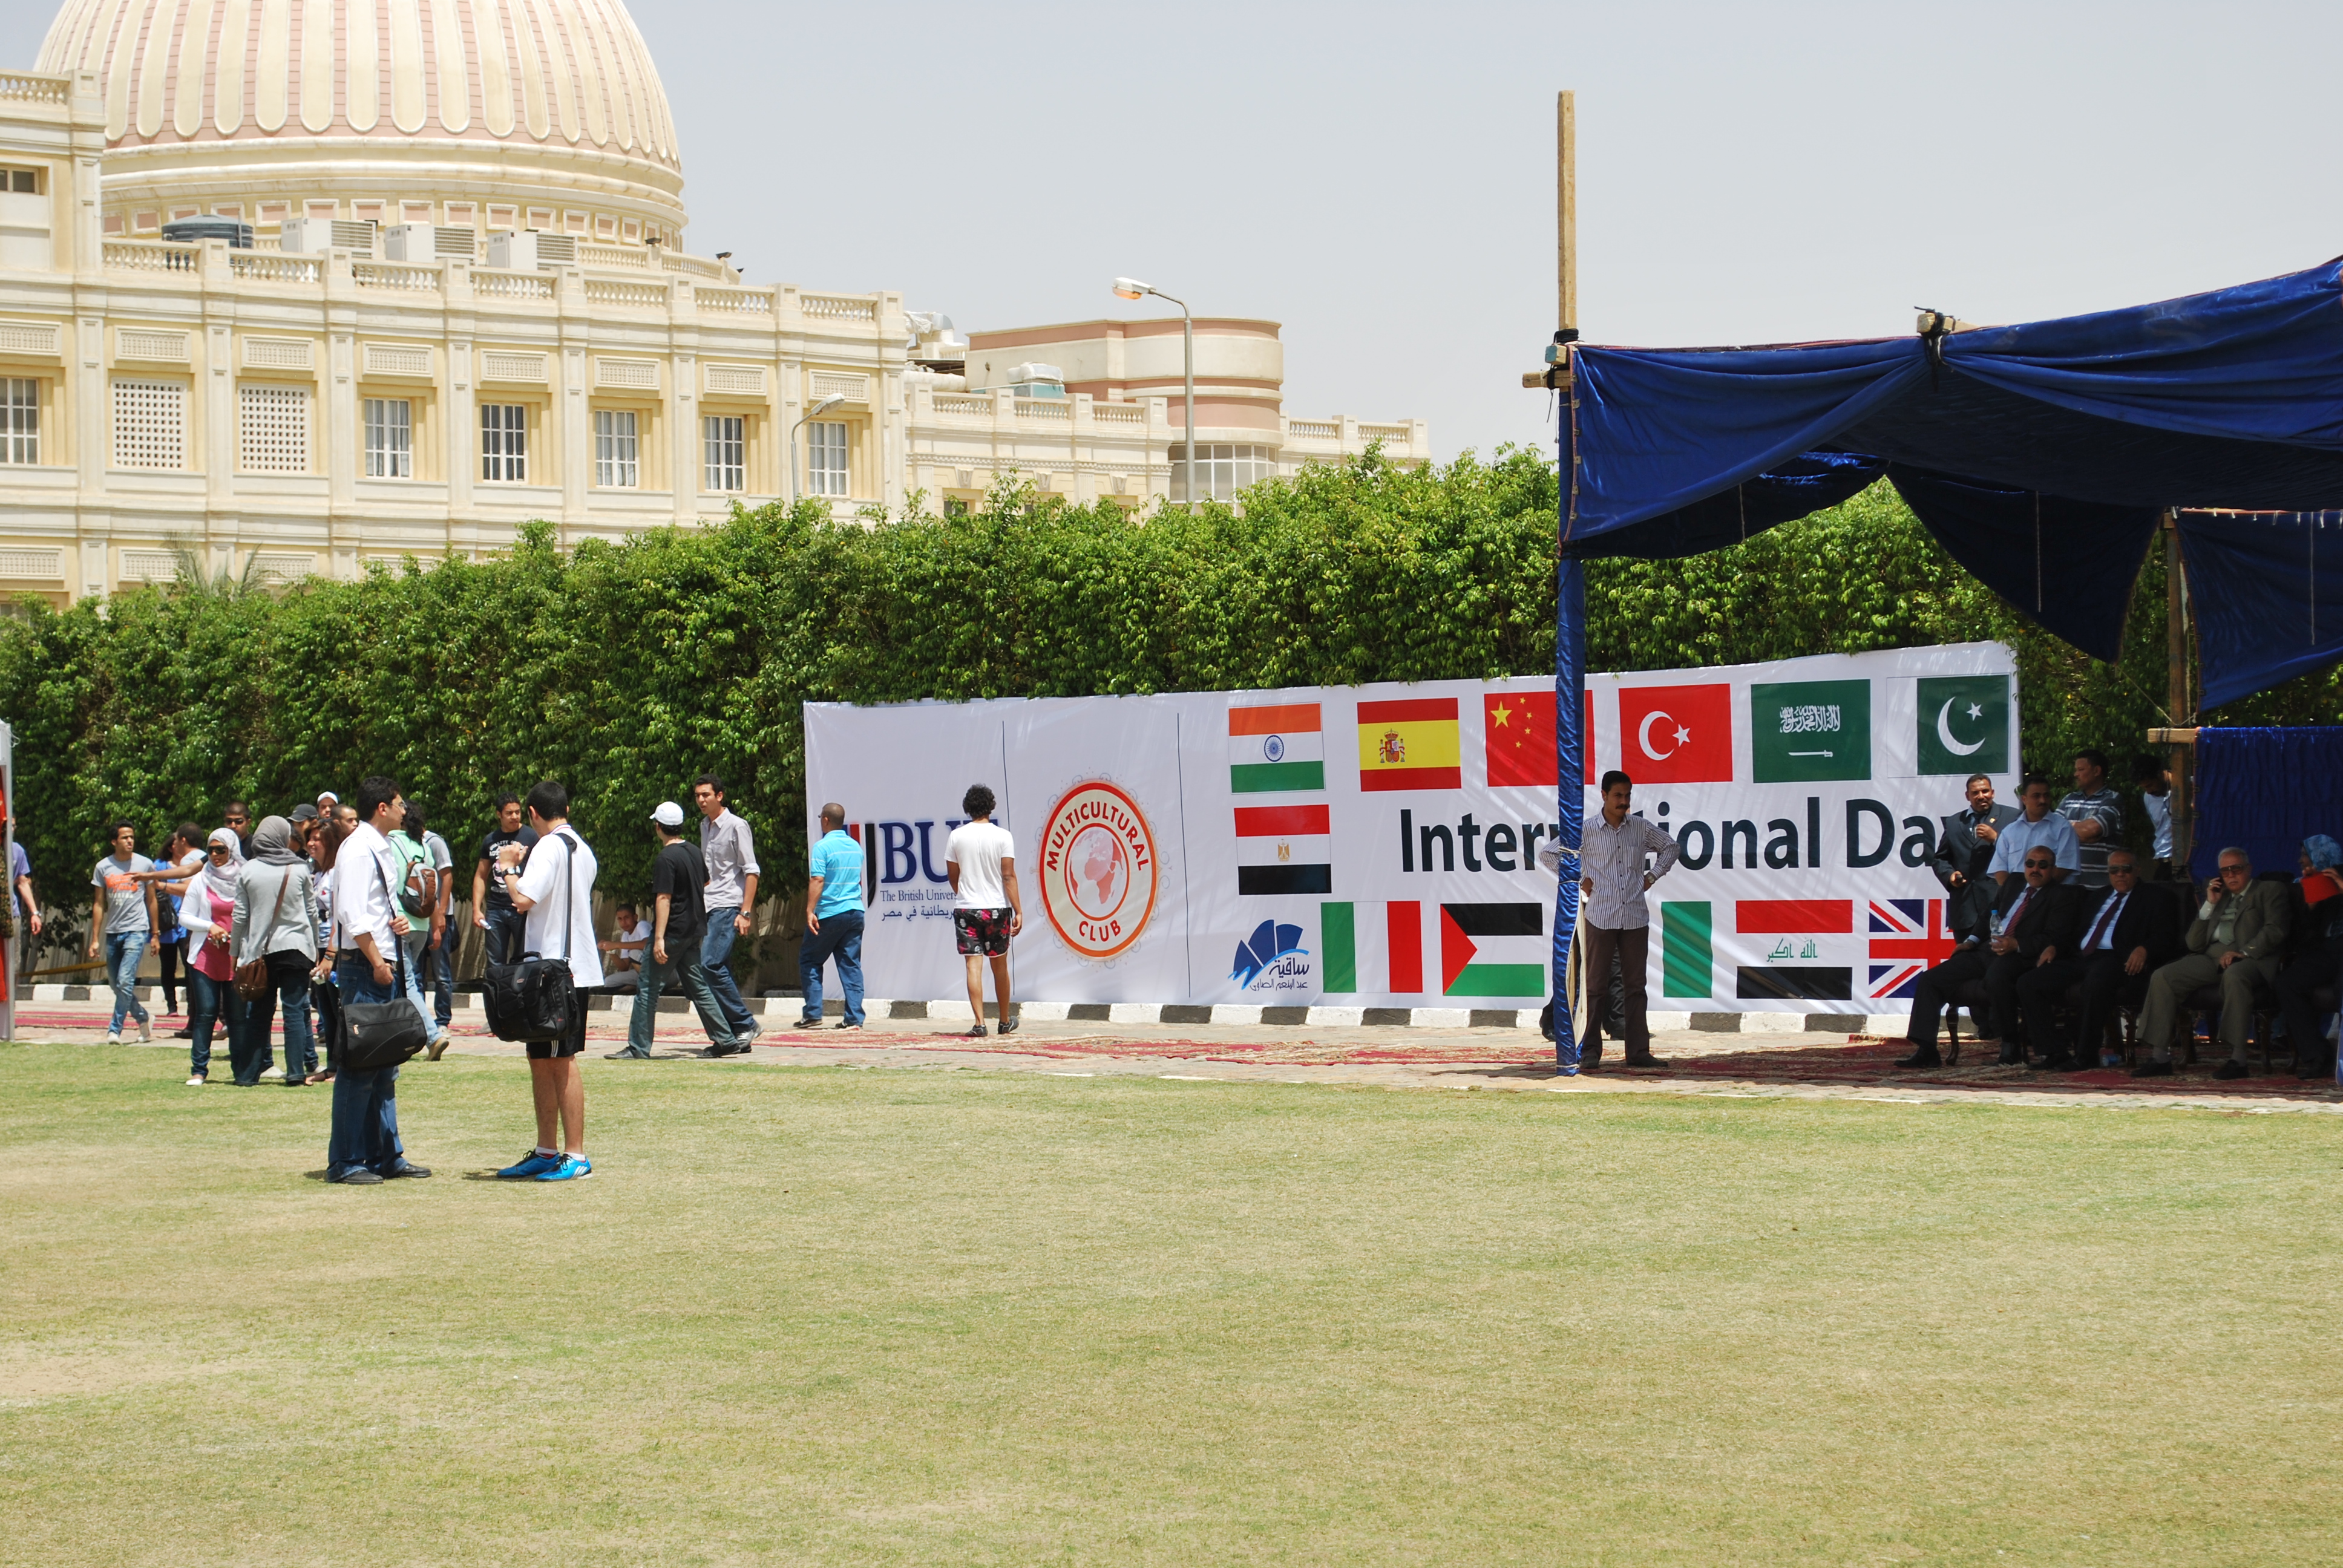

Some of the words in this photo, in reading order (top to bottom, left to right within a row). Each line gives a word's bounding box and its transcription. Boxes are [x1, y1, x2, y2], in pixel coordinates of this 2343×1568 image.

[1046, 801, 1149, 872] MULTICULTURAL
[1400, 797, 1820, 872] Interonal
[1846, 799, 1947, 868] Da
[879, 819, 998, 883] BU
[880, 890, 896, 901] The
[898, 889, 923, 901] British
[882, 910, 902, 921] مصر
[906, 908, 917, 921] في
[1079, 920, 1121, 942] CLUB
[1268, 957, 1309, 978] ساقية
[1296, 981, 1308, 990] عبد
